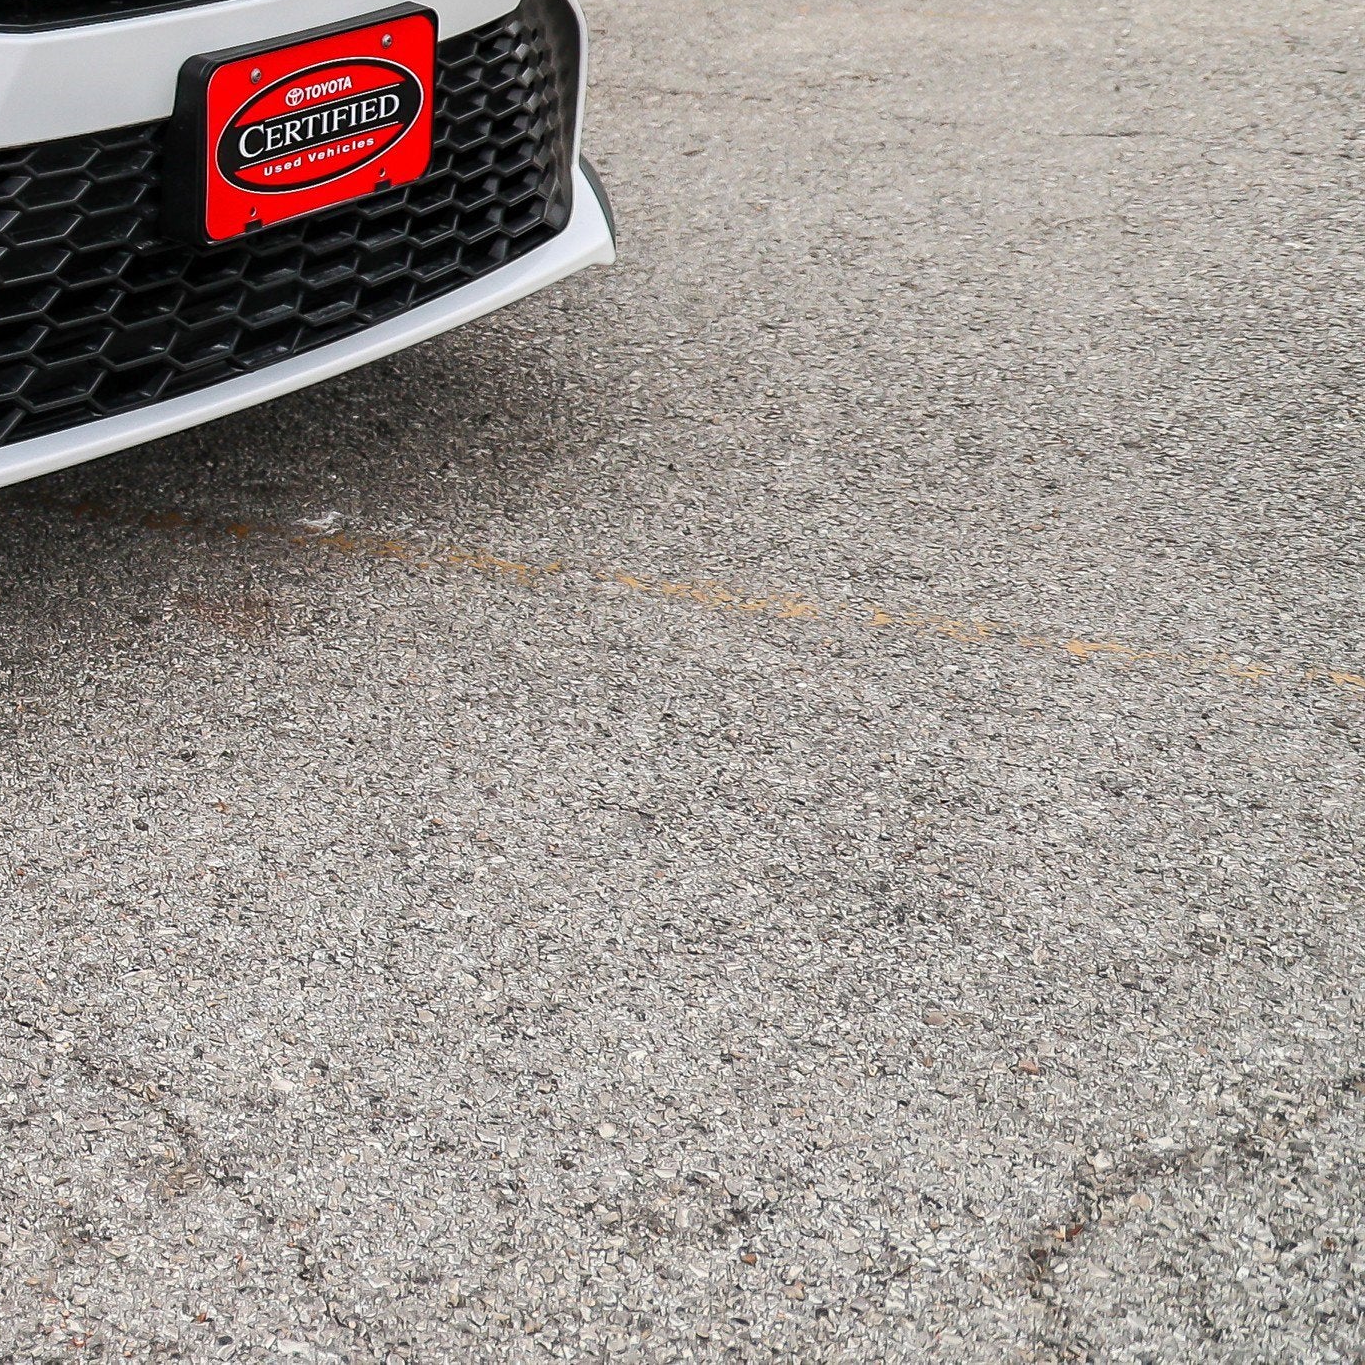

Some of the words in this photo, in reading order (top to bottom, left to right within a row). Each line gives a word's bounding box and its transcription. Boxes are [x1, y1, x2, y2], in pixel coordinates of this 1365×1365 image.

[304, 76, 352, 100] TOYOTA
[238, 93, 400, 158] CERTIFIED
[263, 156, 302, 176] Used
[308, 137, 375, 162] Vehicles
